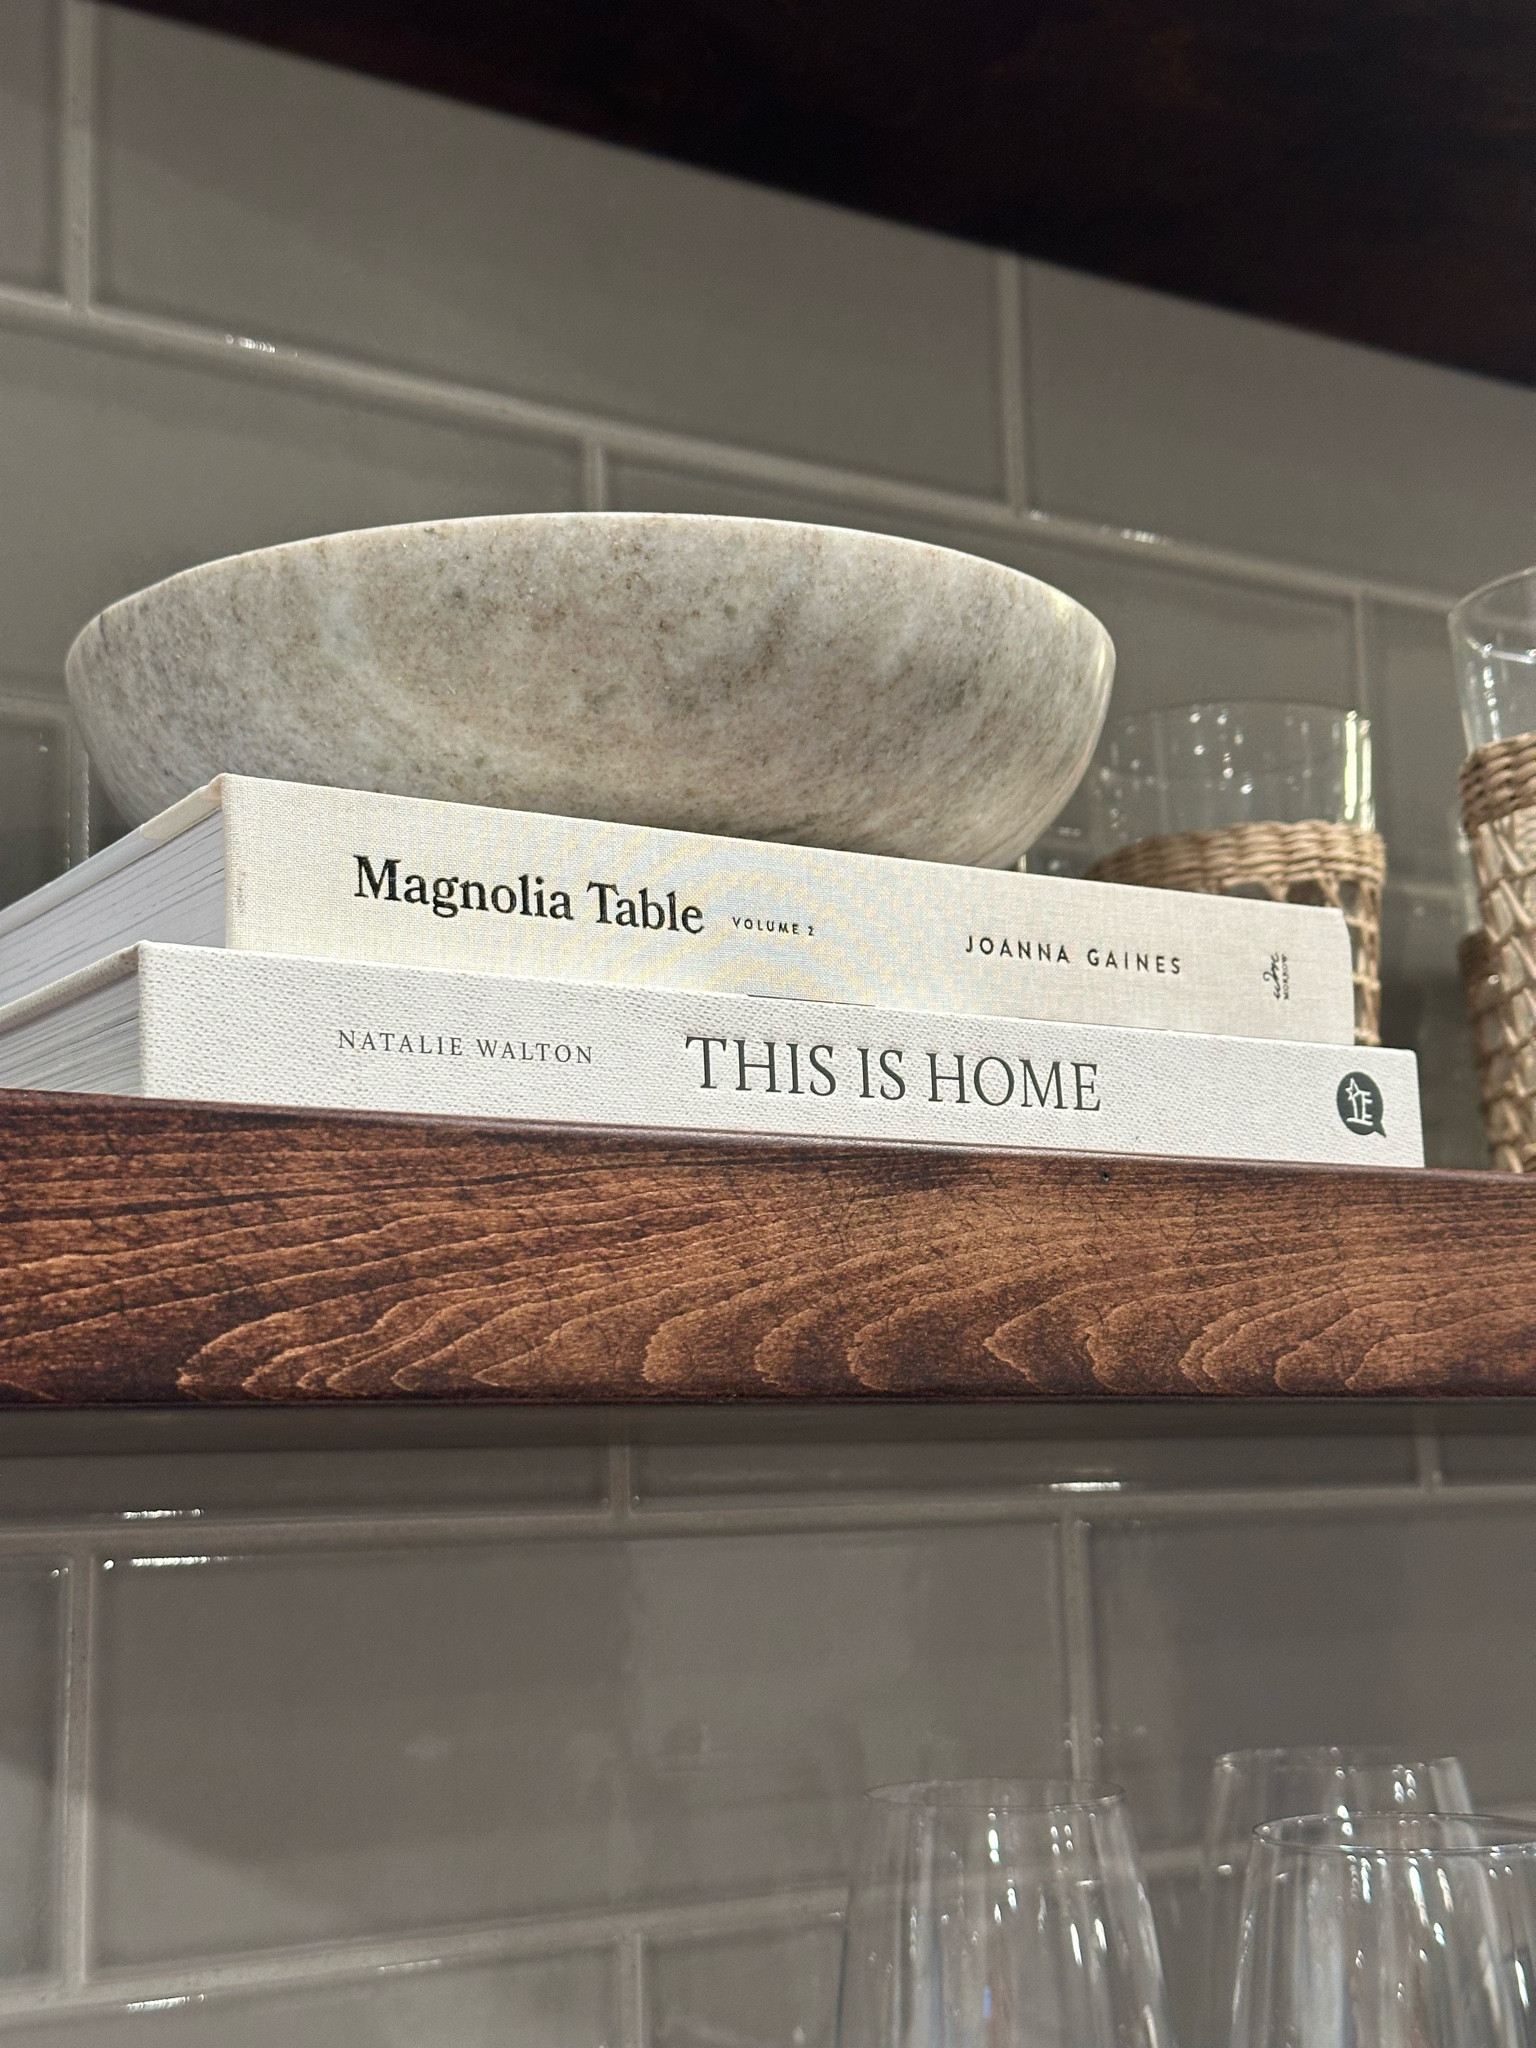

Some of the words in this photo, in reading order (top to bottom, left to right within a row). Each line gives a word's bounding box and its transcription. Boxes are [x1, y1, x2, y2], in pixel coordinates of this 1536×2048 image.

[353, 853, 575, 919] Magnolia
[586, 880, 706, 935] Table
[732, 915, 801, 936] VOLUME
[807, 924, 816, 937] 2
[965, 934, 1071, 964] JOANNA
[1086, 947, 1182, 974] GAINES
[338, 1029, 464, 1057] NATALIE
[475, 1038, 594, 1065] WALTON
[685, 1034, 838, 1097] THIS
[857, 1047, 907, 1102] IS
[926, 1051, 1101, 1112] HOME
